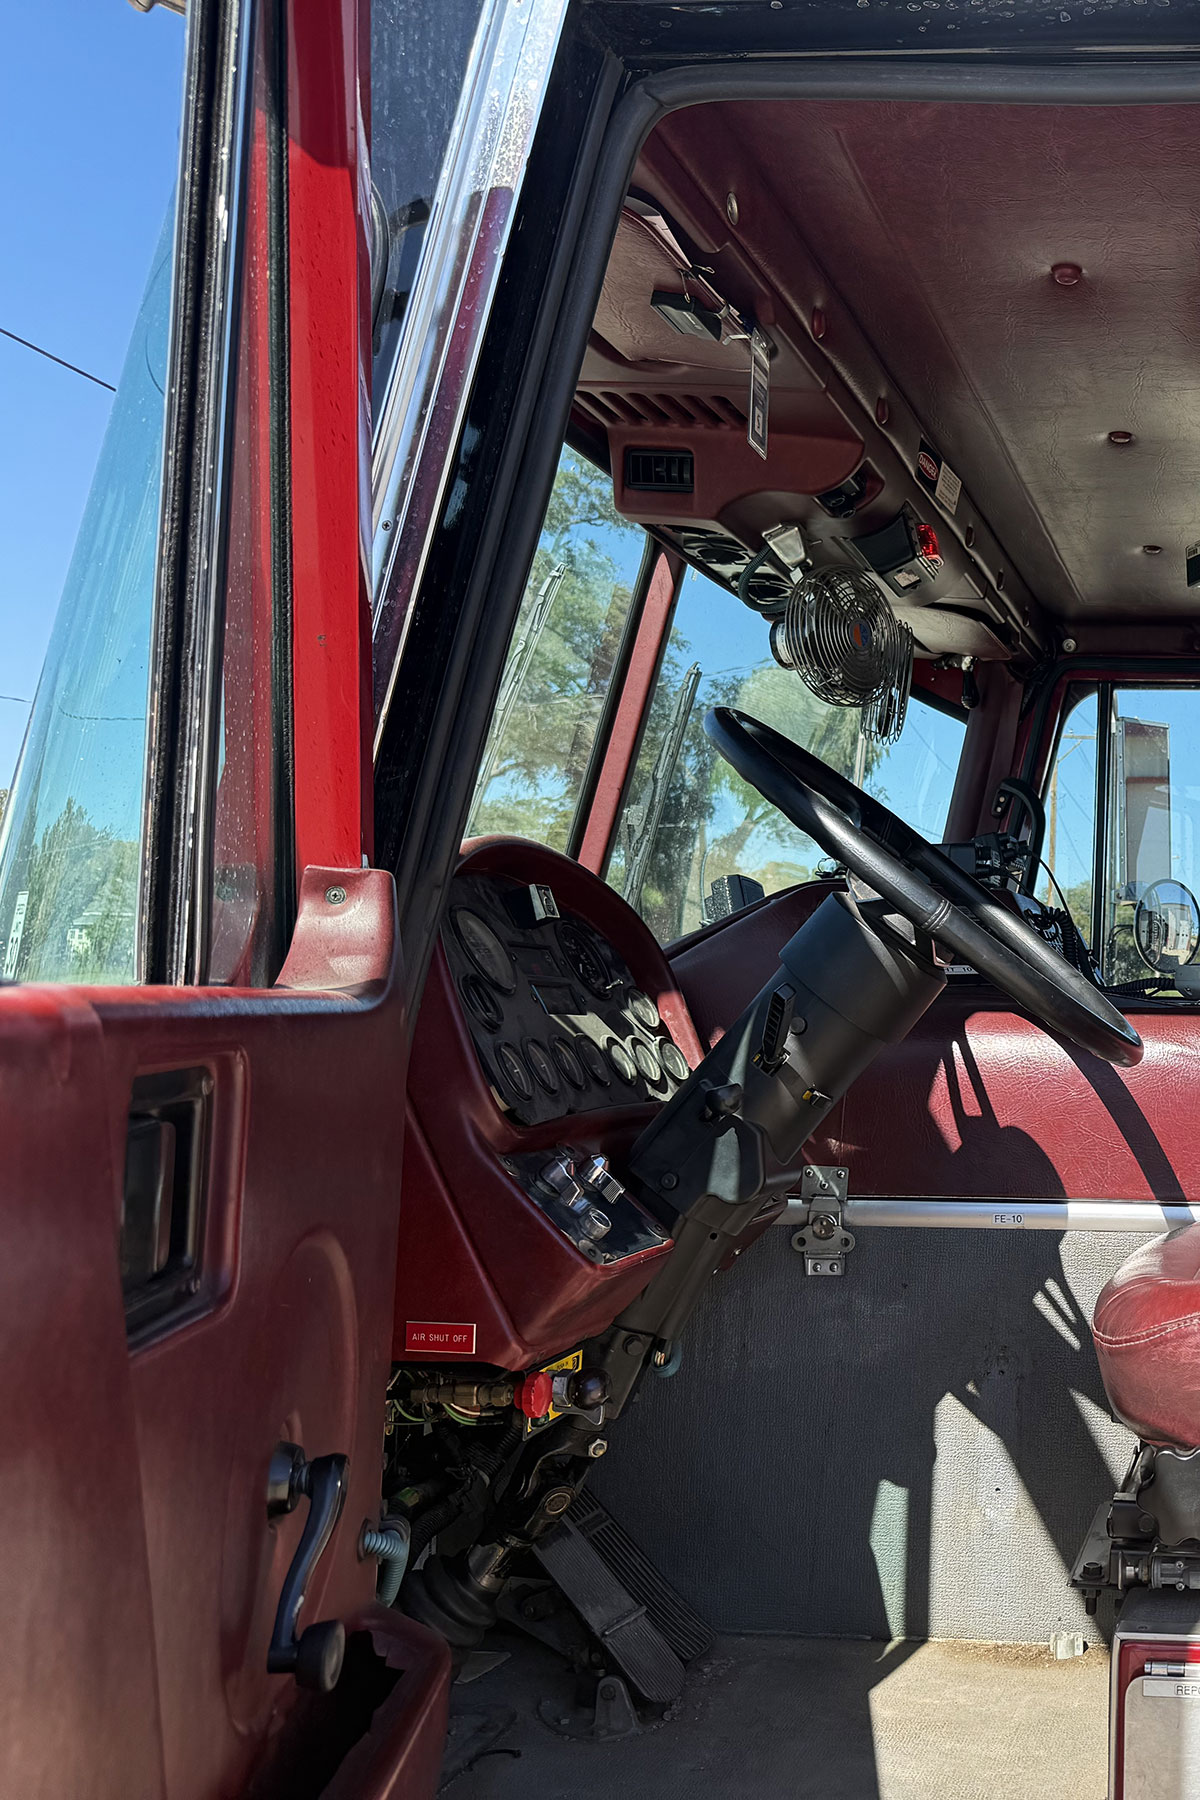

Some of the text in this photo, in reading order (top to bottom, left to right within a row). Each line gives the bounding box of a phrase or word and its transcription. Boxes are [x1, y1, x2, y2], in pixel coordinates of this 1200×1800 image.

[919, 454, 937, 479] DANGER
[994, 1214, 1023, 1223] FE-10
[412, 1332, 468, 1343] AIR SHUT OFF
